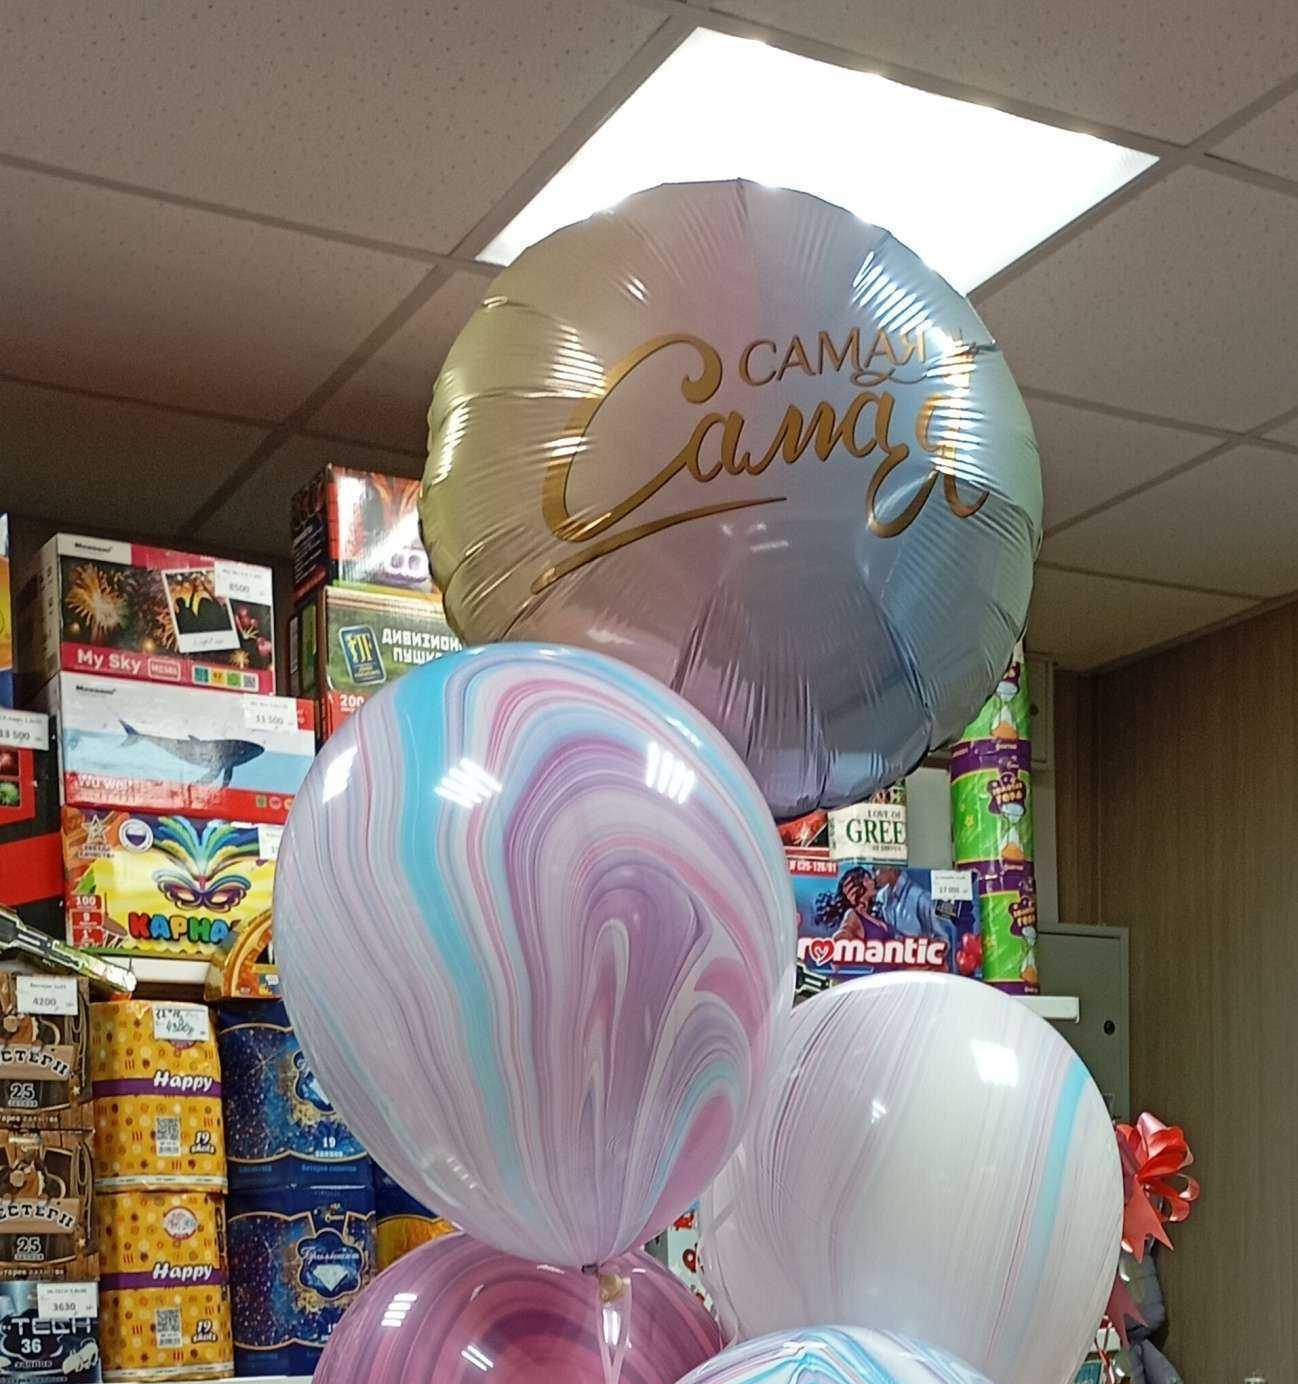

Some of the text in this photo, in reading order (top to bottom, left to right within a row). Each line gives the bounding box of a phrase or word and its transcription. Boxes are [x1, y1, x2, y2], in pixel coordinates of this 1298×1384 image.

[739, 328, 926, 387] САМАЯ
[77, 648, 104, 670] My
[109, 653, 142, 674] Sky
[153, 1069, 213, 1092] Happy
[10, 1083, 36, 1099] 25
[195, 1131, 211, 1145] 19
[323, 1136, 336, 1148] 19
[16, 1237, 42, 1254] 25
[152, 1261, 213, 1281] Happy
[197, 1319, 212, 1333] 19
[21, 1338, 42, 1354] 36
